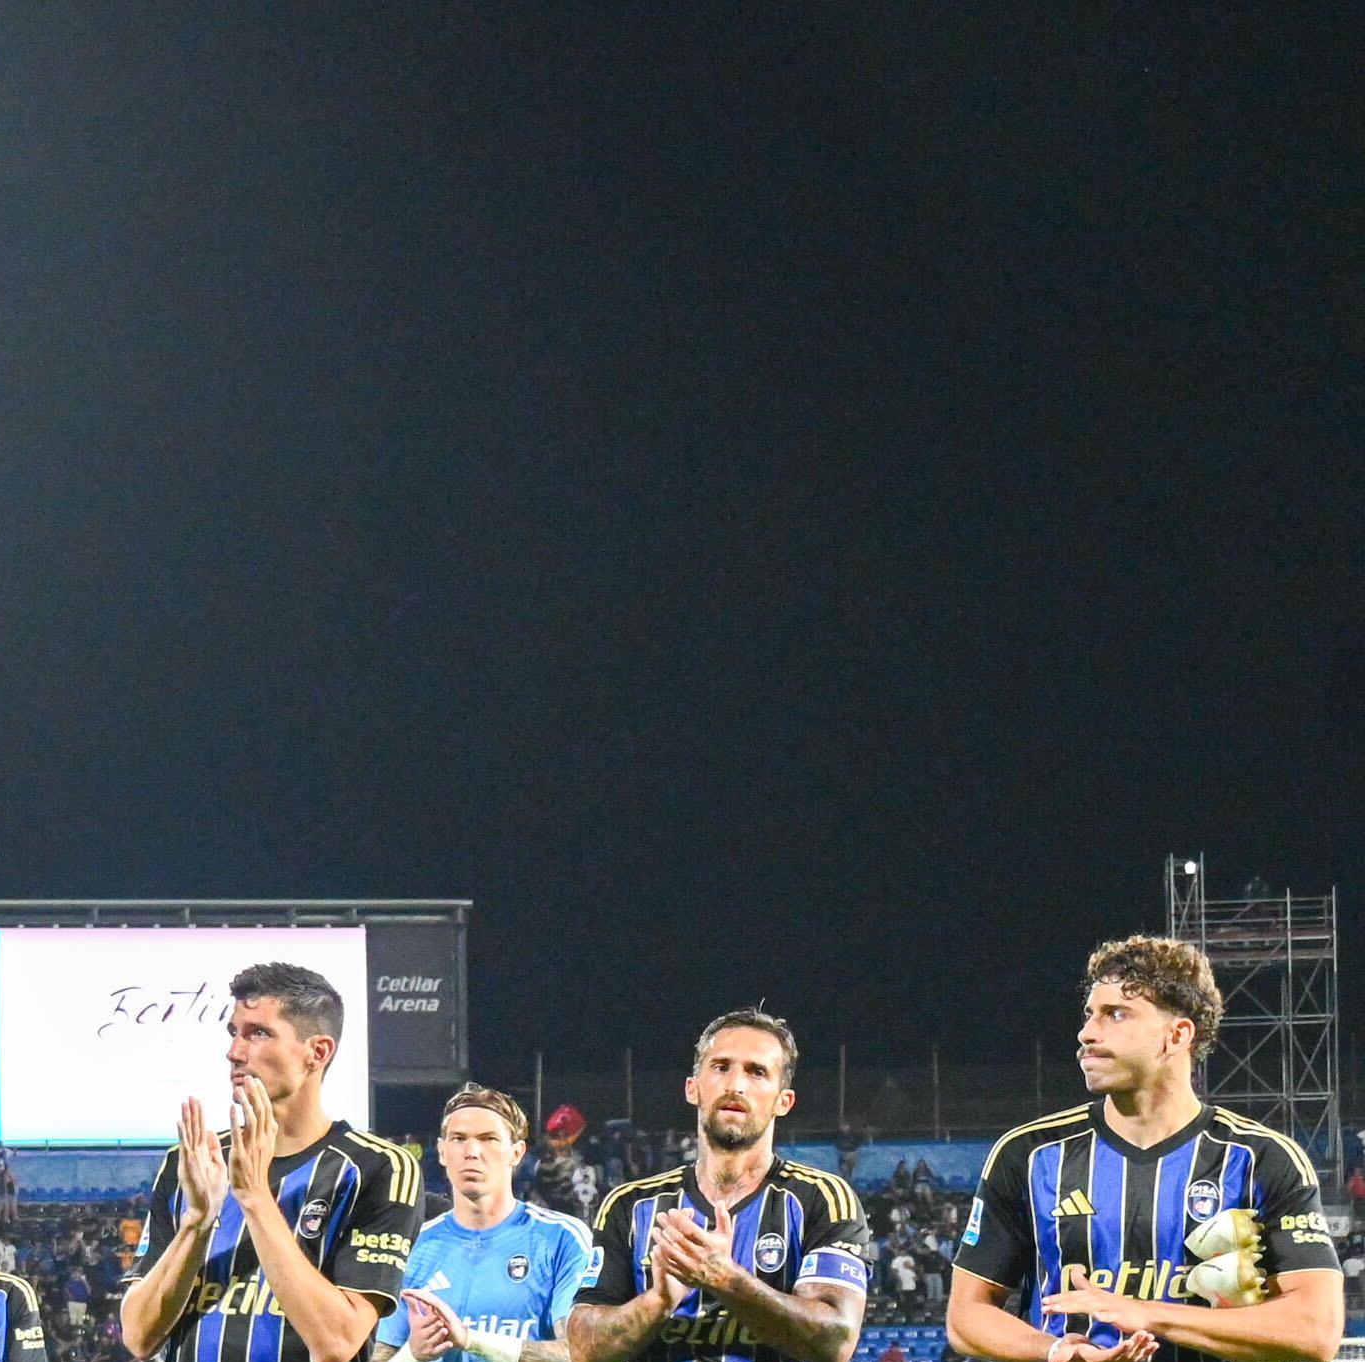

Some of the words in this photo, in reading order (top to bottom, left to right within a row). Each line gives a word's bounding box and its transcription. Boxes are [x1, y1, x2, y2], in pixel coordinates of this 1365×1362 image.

[376, 975, 443, 992] Cetilar
[378, 995, 441, 1012] Arena
[1190, 1184, 1218, 1196] PISA
[350, 1229, 411, 1257] bet36
[1060, 1260, 1193, 1300] Cetila
[464, 1315, 537, 1340] tilar
